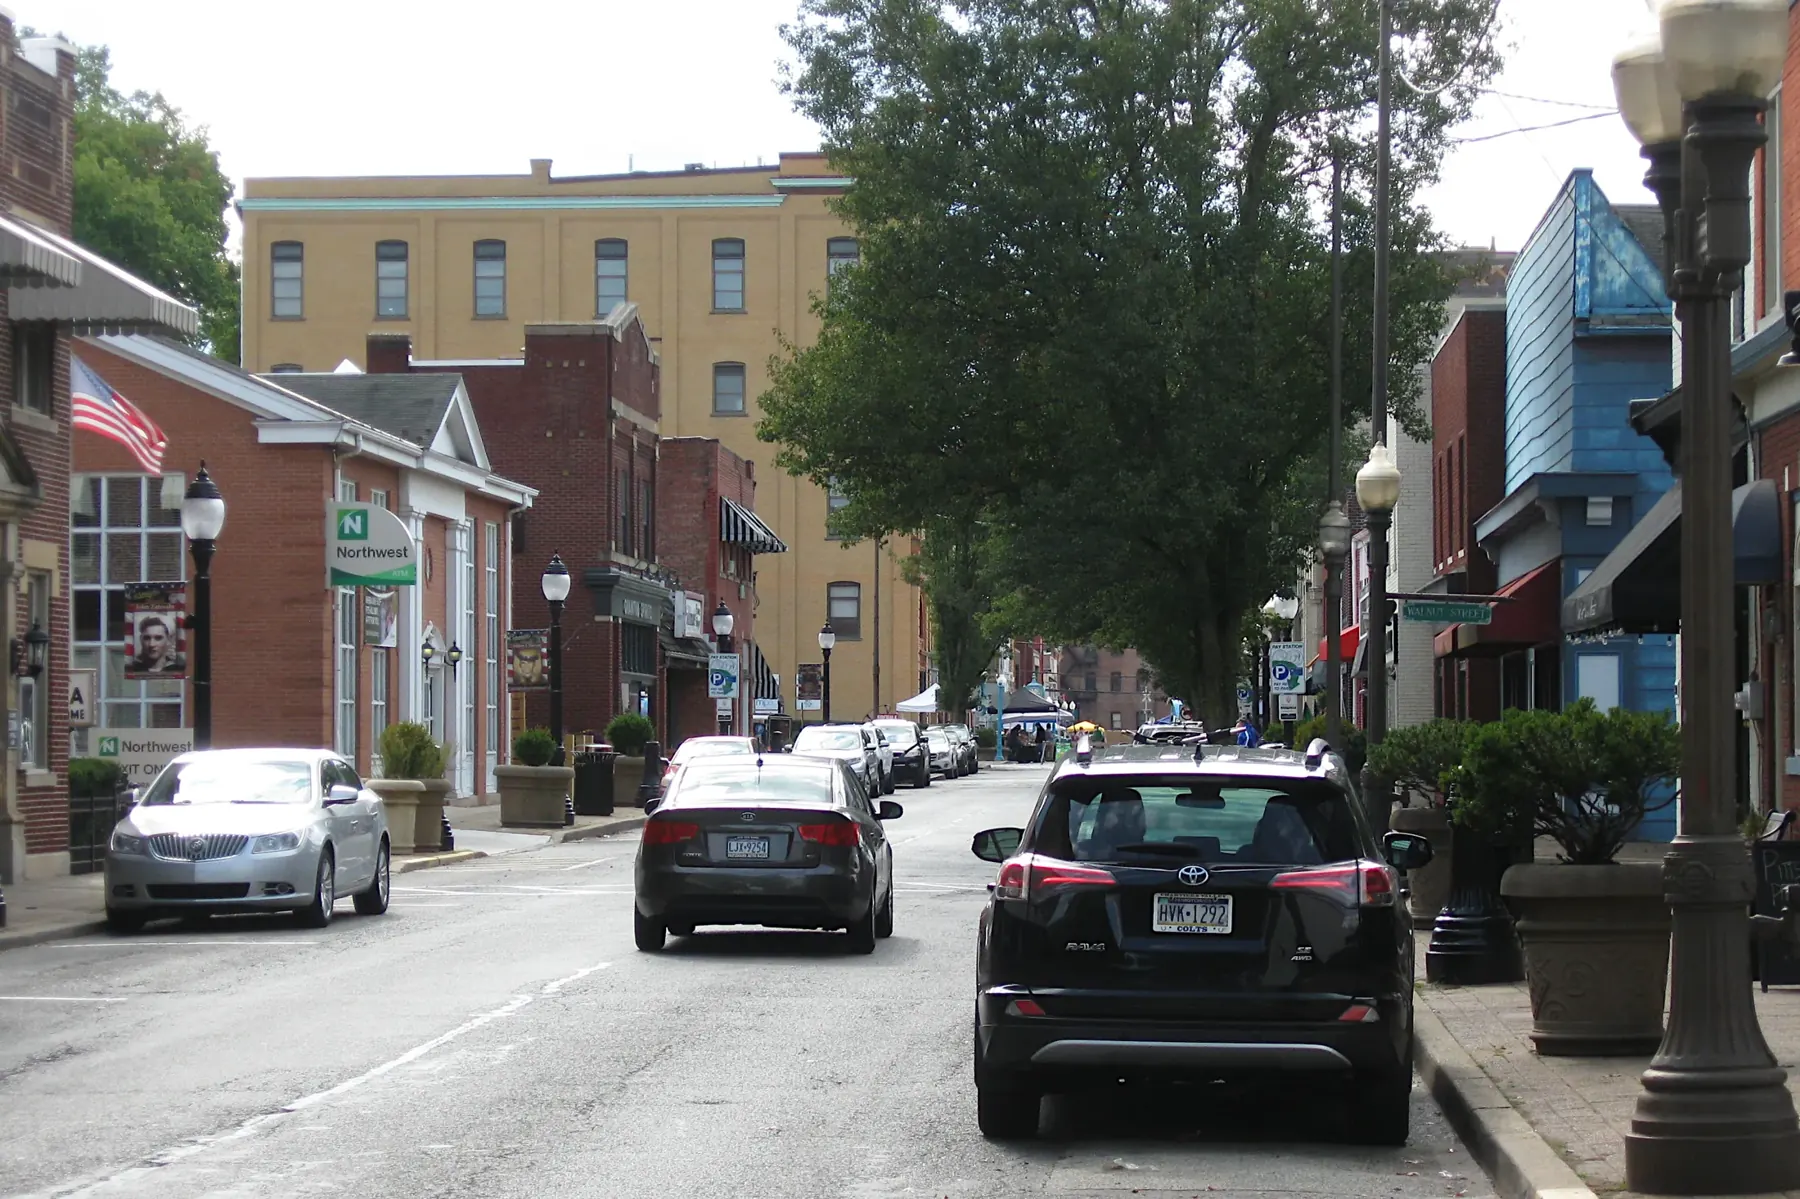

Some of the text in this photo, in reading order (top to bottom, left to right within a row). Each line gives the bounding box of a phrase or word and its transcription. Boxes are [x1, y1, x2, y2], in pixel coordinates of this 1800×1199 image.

[343, 515, 362, 534] N
[336, 546, 409, 559] Northwest
[1407, 606, 1485, 619] WALNUT STREET
[1275, 666, 1285, 678] P
[713, 674, 721, 684] P
[122, 740, 192, 753] Northwest
[121, 763, 140, 775] XIT
